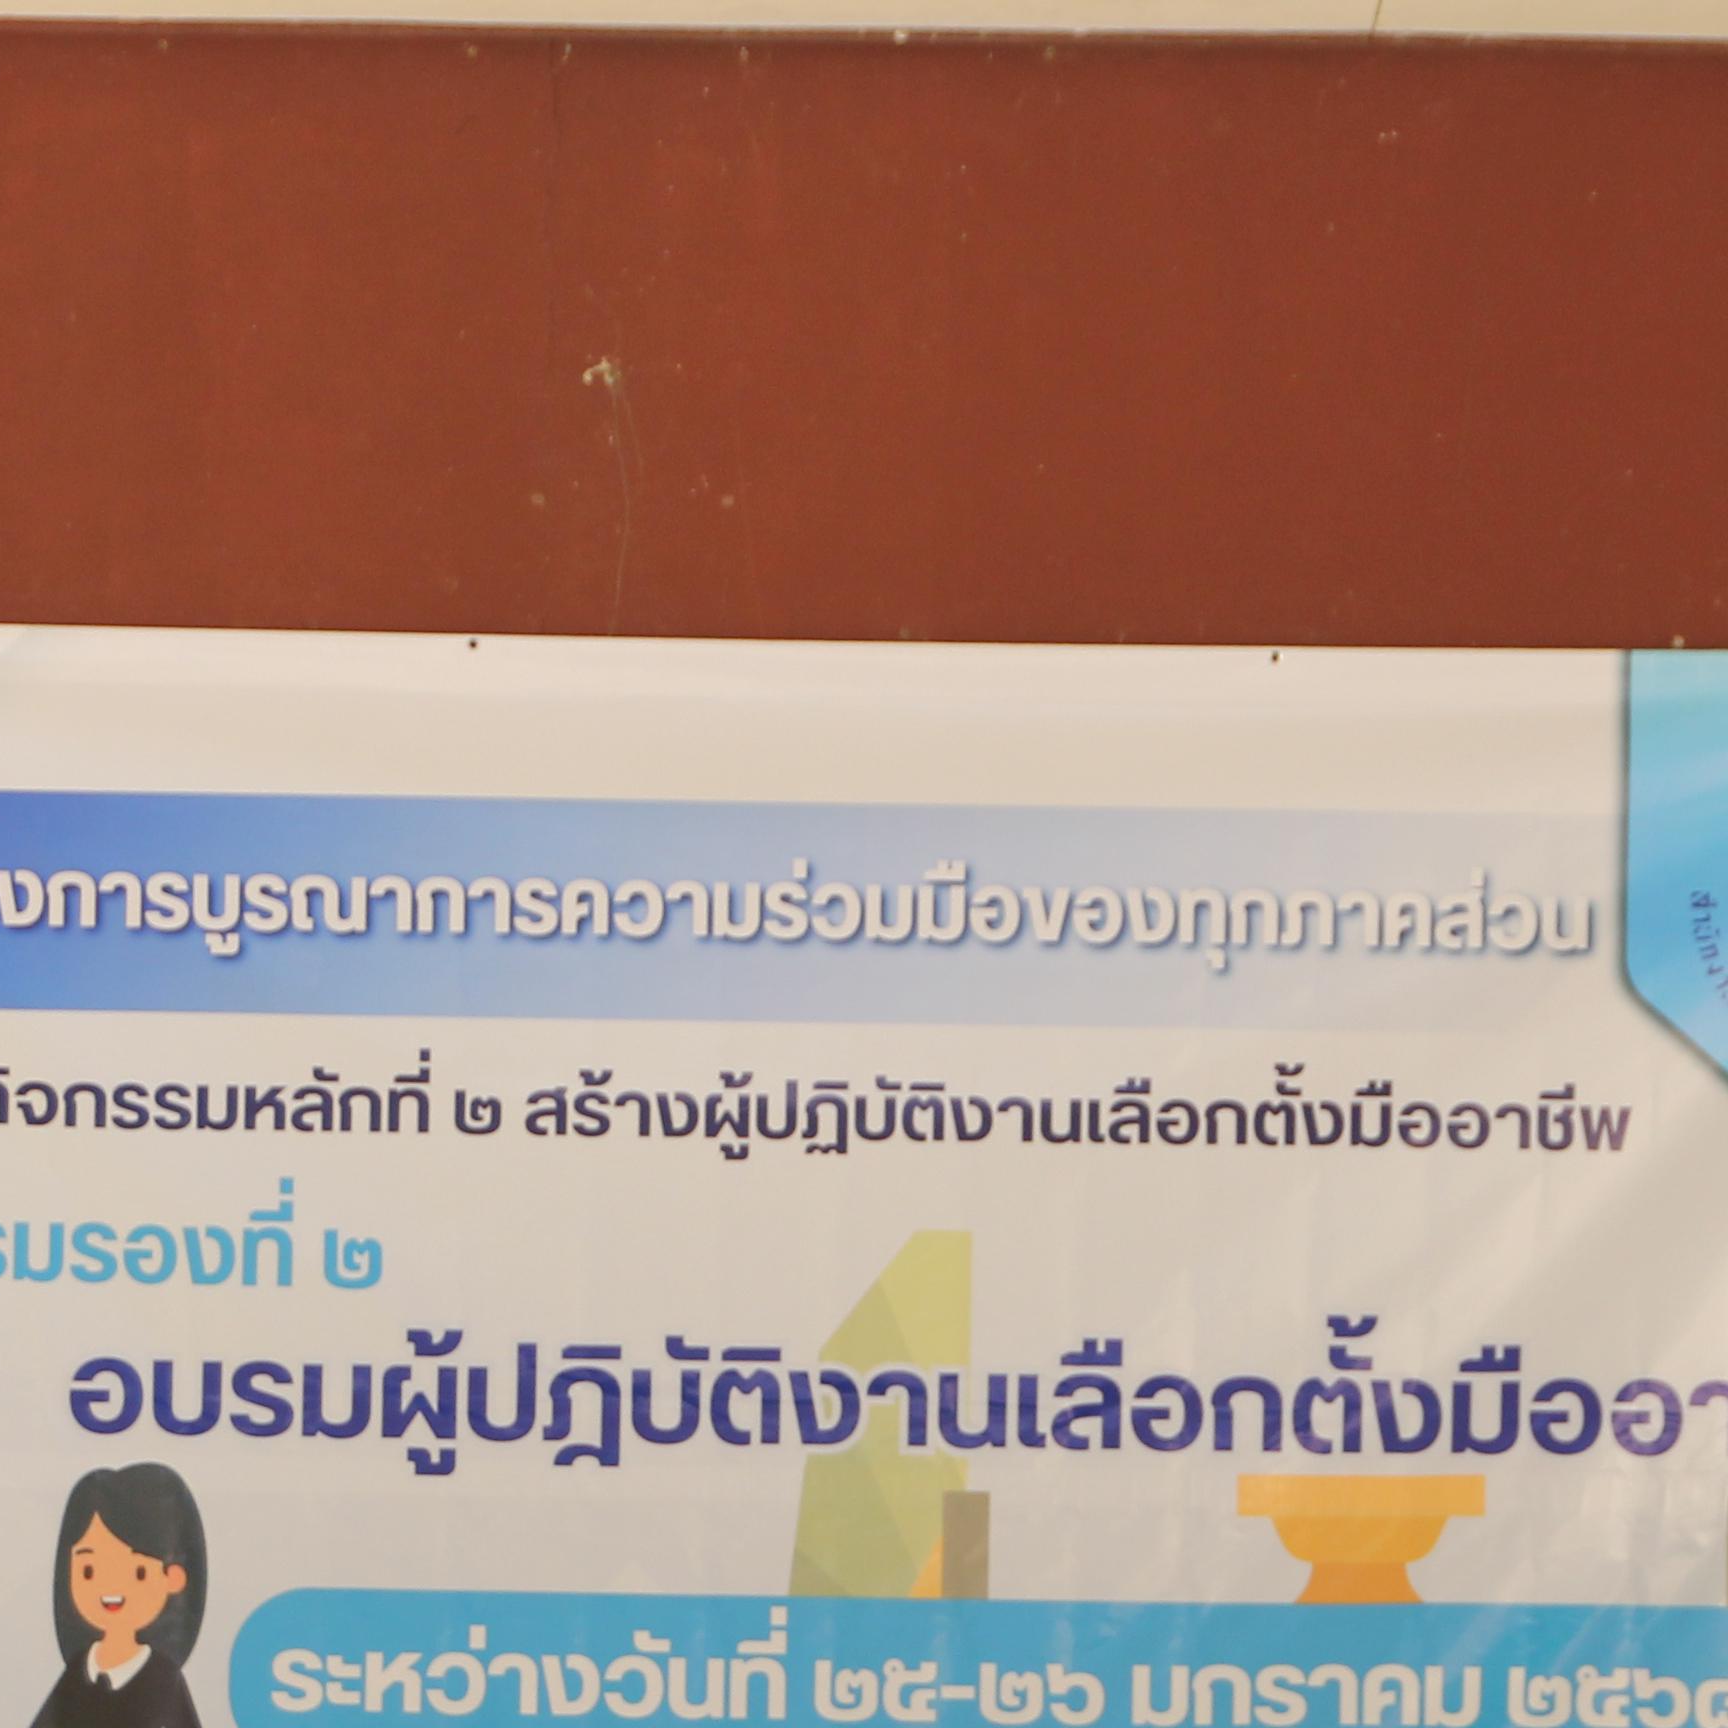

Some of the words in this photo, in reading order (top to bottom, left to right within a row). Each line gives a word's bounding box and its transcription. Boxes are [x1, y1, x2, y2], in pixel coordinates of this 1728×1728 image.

[453, 1087, 504, 1136] ๒
[523, 1063, 1633, 1160] สร้างผู้ปฏิบัติงานเลือกตั้งมืออาชีพ
[322, 1227, 385, 1291] ๒
[271, 1605, 790, 1720] ระหว่างวันที่
[813, 1655, 1107, 1727] ๒๕-๒๖
[1130, 1662, 1483, 1728] มกราคม
